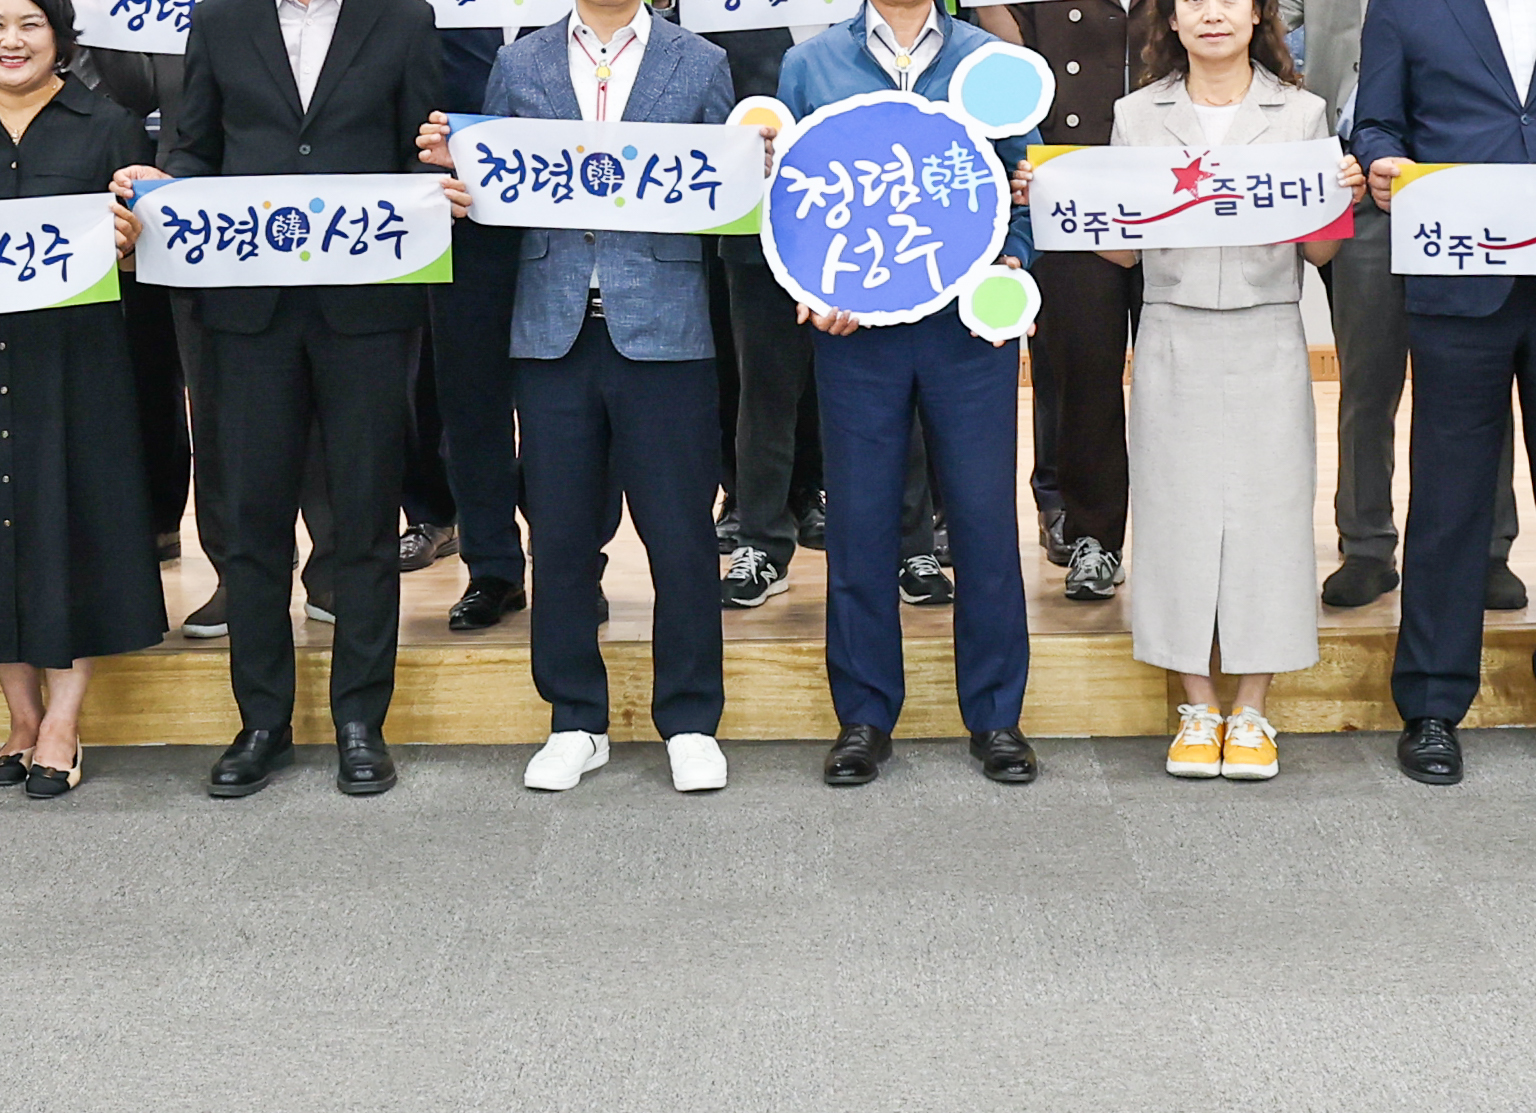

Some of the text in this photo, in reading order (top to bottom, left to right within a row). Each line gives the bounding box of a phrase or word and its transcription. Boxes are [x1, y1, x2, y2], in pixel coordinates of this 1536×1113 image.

[636, 149, 723, 211] 성주
[1050, 172, 1326, 245] 성주는 즐겁다!
[321, 199, 409, 261] 성주
[821, 213, 944, 295] 성주
[1413, 221, 1508, 270] 성주는
